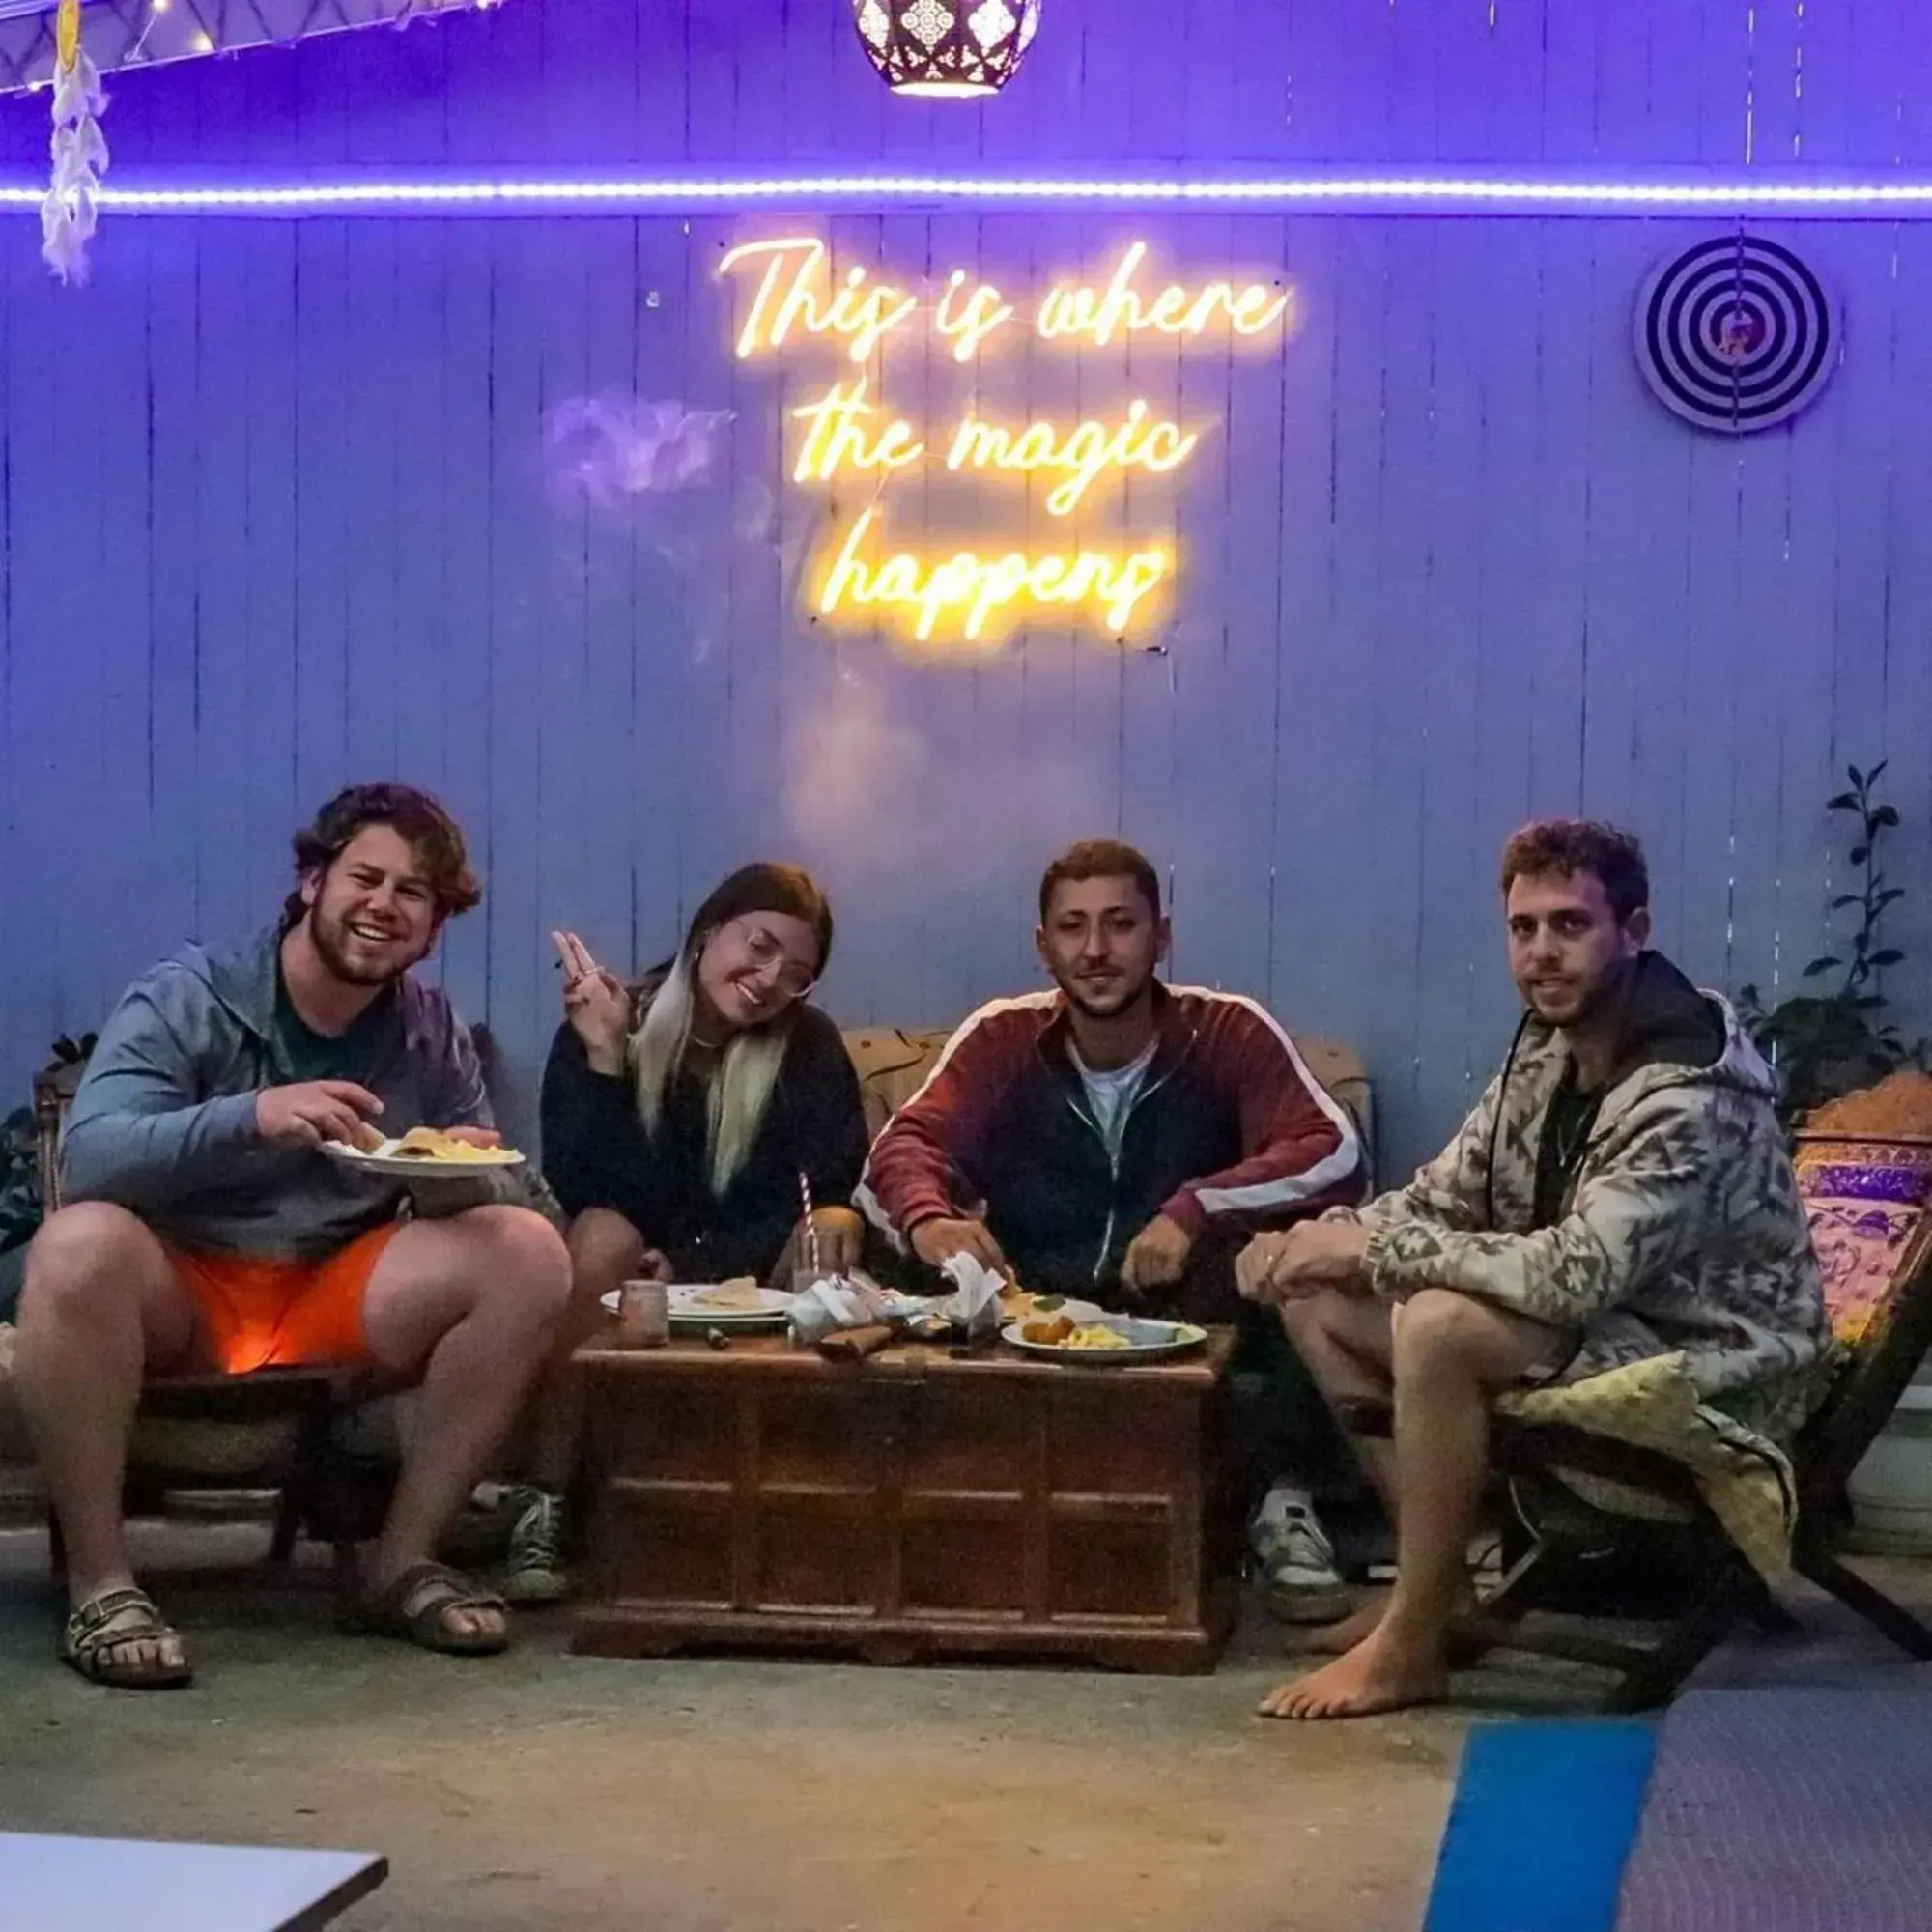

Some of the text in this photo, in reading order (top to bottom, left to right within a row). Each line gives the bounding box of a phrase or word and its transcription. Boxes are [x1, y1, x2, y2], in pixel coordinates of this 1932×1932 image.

[718, 238, 1289, 362] This is where
[790, 378, 1198, 515] the magic
[819, 505, 1169, 639] happens
